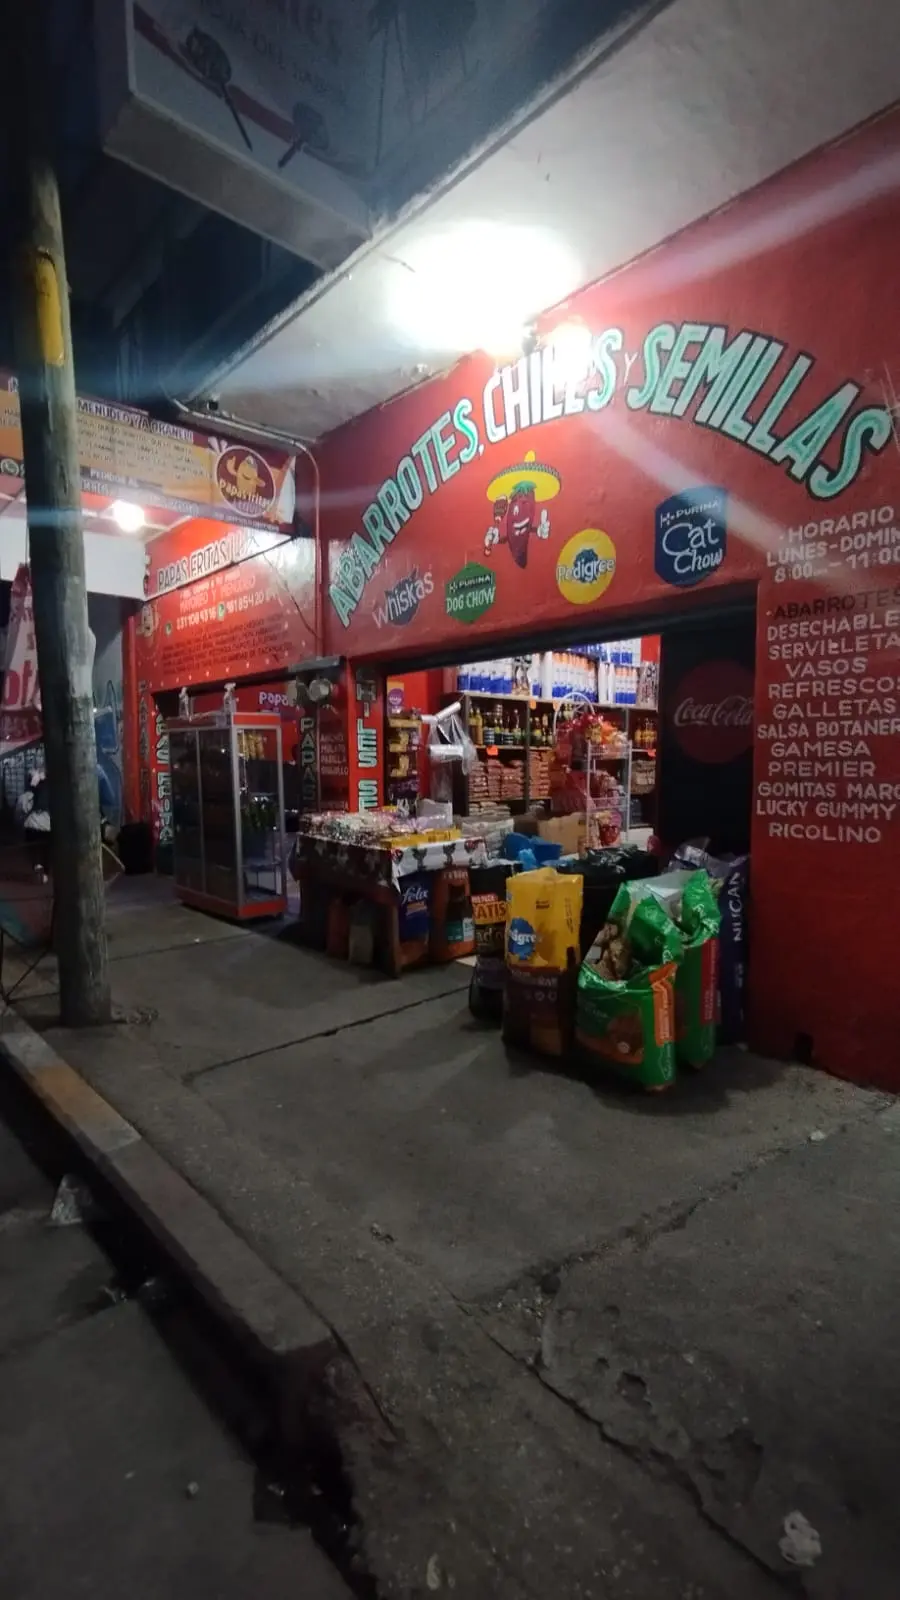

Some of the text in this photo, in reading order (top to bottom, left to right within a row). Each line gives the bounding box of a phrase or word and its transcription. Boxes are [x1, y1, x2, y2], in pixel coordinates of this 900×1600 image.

[329, 398, 485, 628] ABARROTES,
[627, 321, 893, 500] SEMILLAS
[788, 505, 894, 542] HORARIO
[662, 518, 719, 556] Cat
[557, 556, 616, 584] Pedigree
[673, 548, 723, 574] Chow
[157, 554, 190, 598] PAPAS
[447, 586, 496, 613] DOG CHOW
[767, 610, 900, 641] DESECHABLE
[785, 657, 868, 678] VASOS
[768, 676, 900, 699] REFRESCO
[772, 698, 896, 720] GALLETAS
[757, 723, 809, 740] SALSA
[771, 740, 871, 758] GAMESA
[768, 761, 877, 777] PREMIER
[758, 781, 836, 798] GOMITAS
[756, 799, 897, 820] LUCKY GUMMY
[768, 822, 882, 843] RICOLINO
